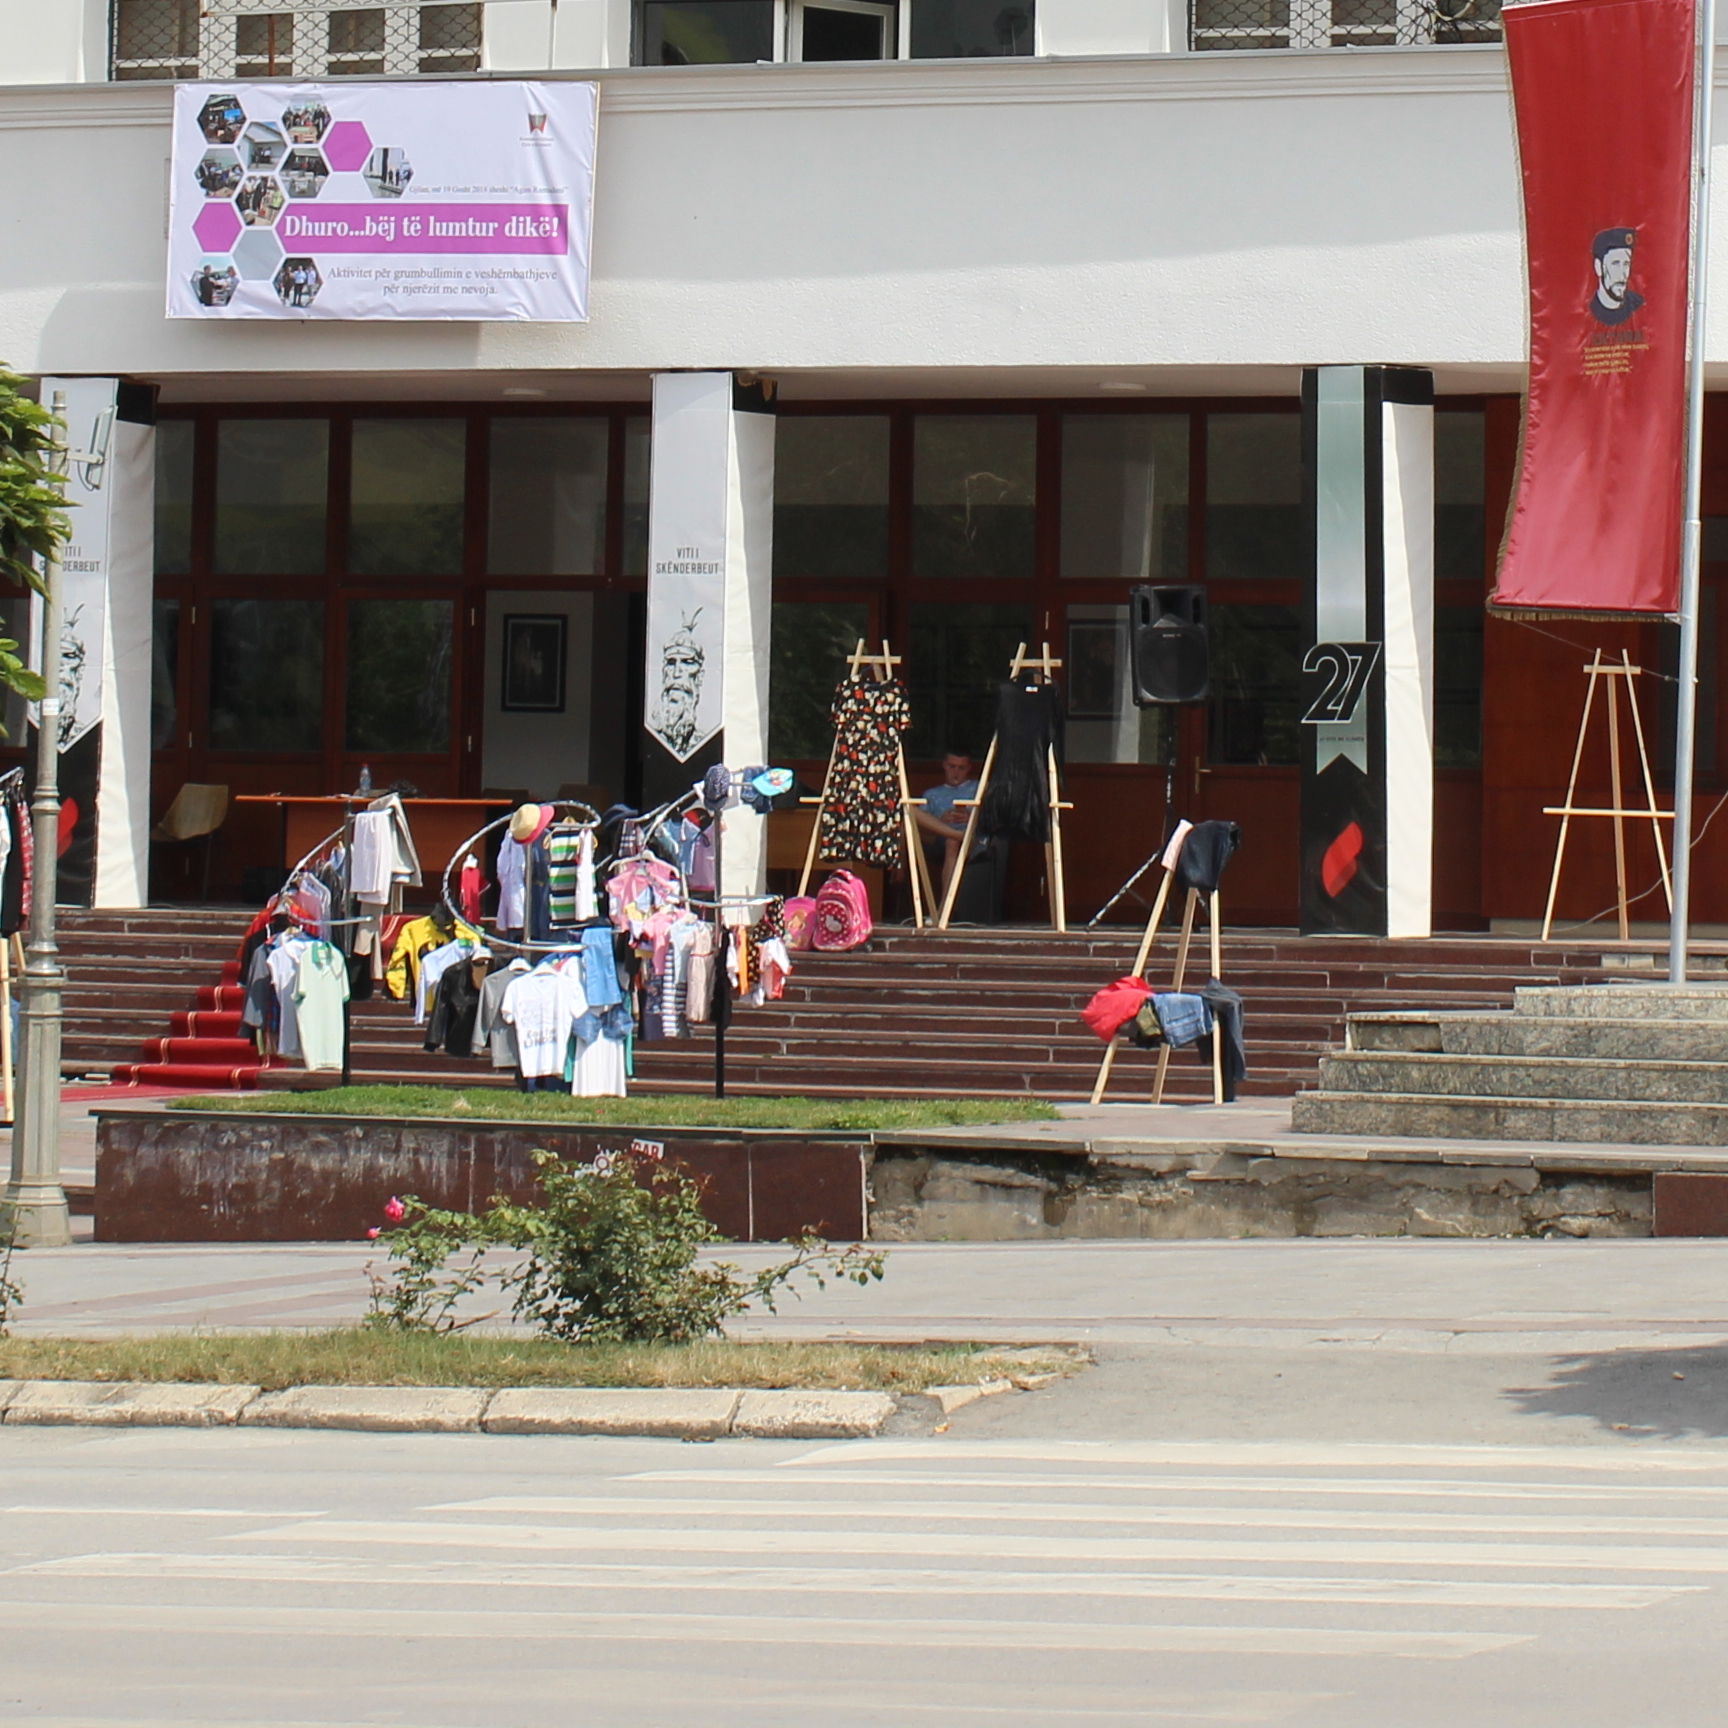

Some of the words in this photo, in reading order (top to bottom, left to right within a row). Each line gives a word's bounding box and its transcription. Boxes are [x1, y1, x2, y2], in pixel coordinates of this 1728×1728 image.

[283, 215, 396, 242] Dhuro...bëj
[402, 216, 422, 238] të
[427, 215, 499, 238] lumtur
[504, 215, 559, 238] dikë!
[327, 267, 372, 278] Aktivitet
[374, 268, 391, 280] për
[393, 267, 463, 281] grumbullimin
[383, 283, 400, 296] për
[402, 283, 440, 297] njerëzit
[442, 285, 459, 294] me
[676, 547, 694, 559] VITI
[39, 560, 100, 572] SDERBEUT
[655, 560, 719, 574] SKËNDERBEUT
[1301, 641, 1382, 724] 27
